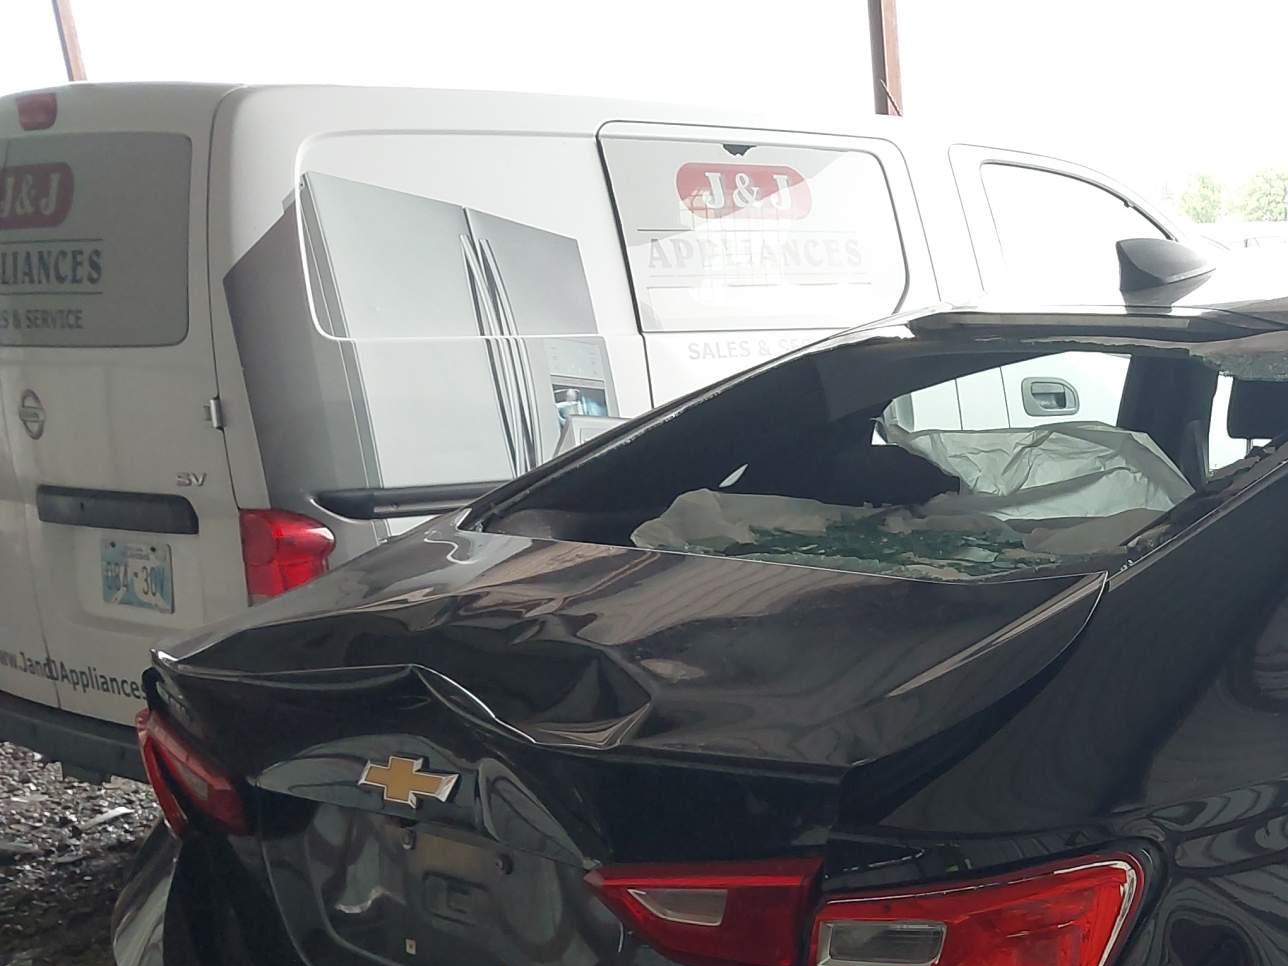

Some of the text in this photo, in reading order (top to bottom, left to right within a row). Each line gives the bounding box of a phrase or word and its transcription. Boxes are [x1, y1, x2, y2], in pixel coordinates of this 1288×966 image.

[647, 237, 863, 269] APPLIANCES
[25, 308, 83, 329] SERVICE
[687, 340, 751, 361] SALES
[757, 339, 773, 357] &
[176, 472, 207, 487] SV
